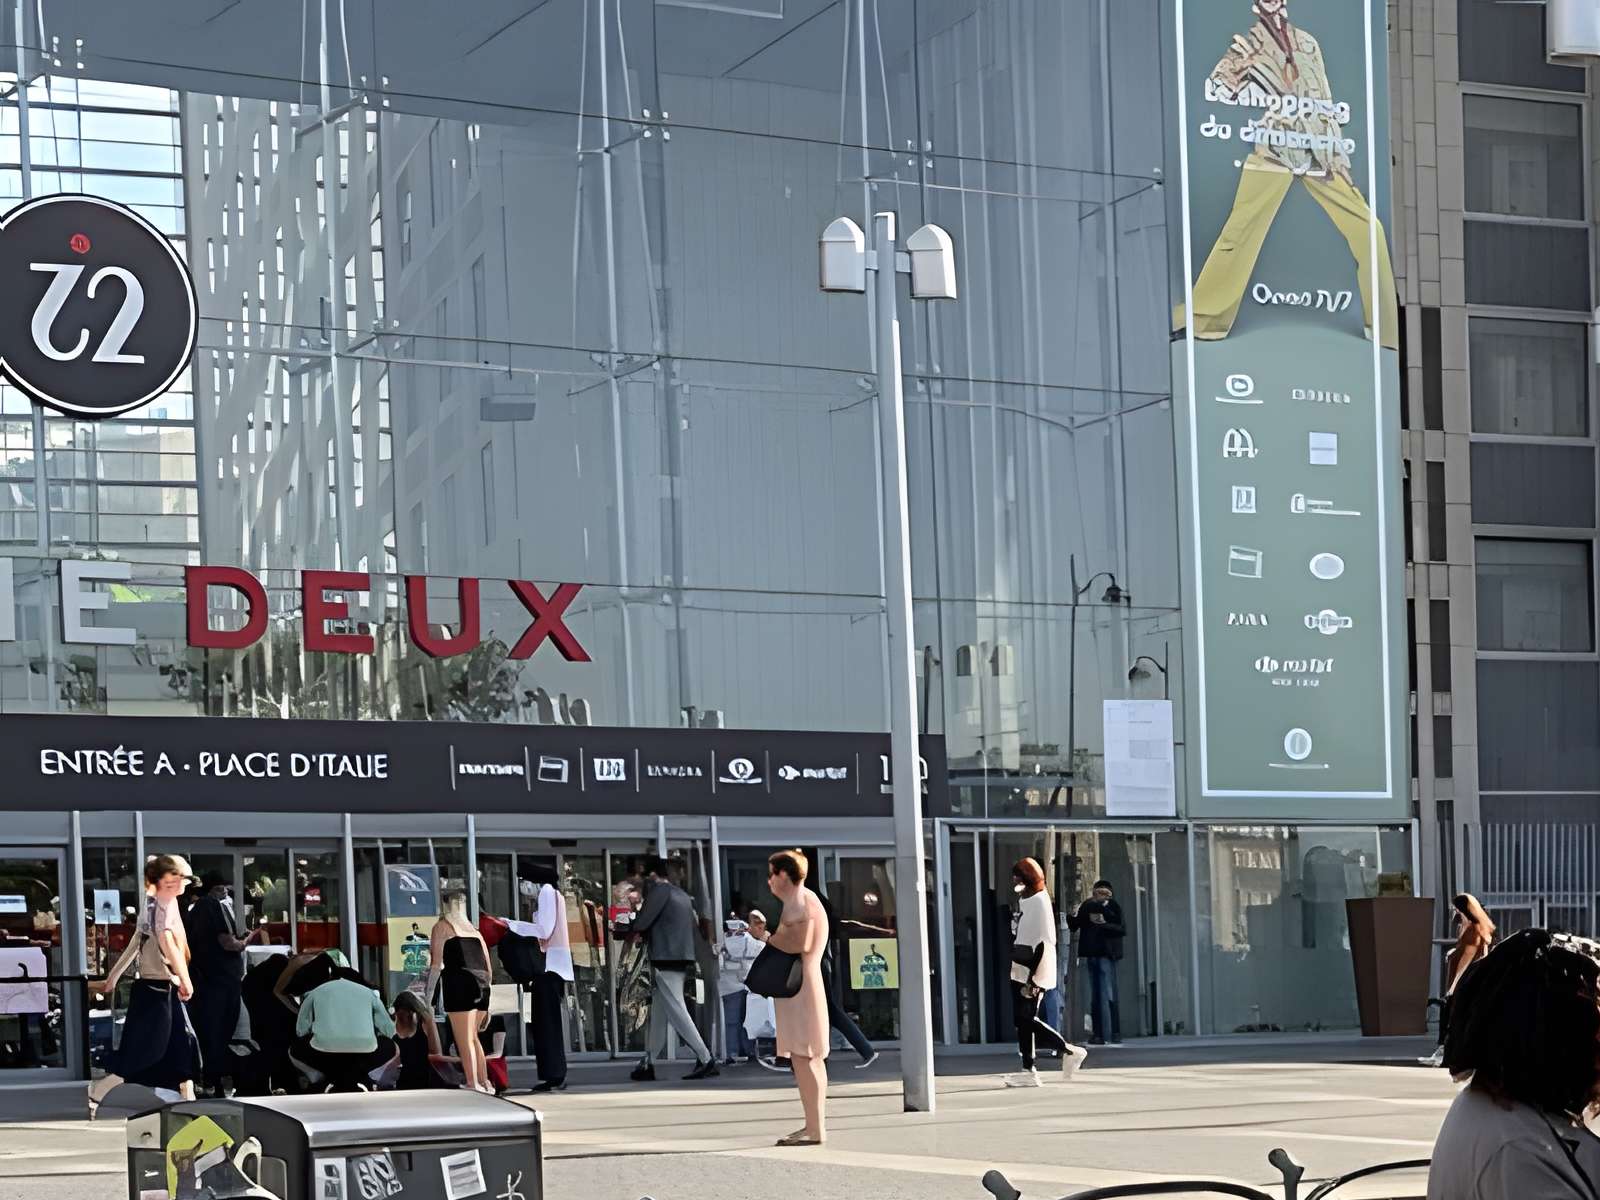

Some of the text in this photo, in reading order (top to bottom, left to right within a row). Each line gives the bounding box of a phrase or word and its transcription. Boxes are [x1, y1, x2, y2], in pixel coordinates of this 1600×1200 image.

[184, 564, 592, 663] DEUX
[40, 744, 388, 778] ENTRÉE A PLACE D'ITALIE
